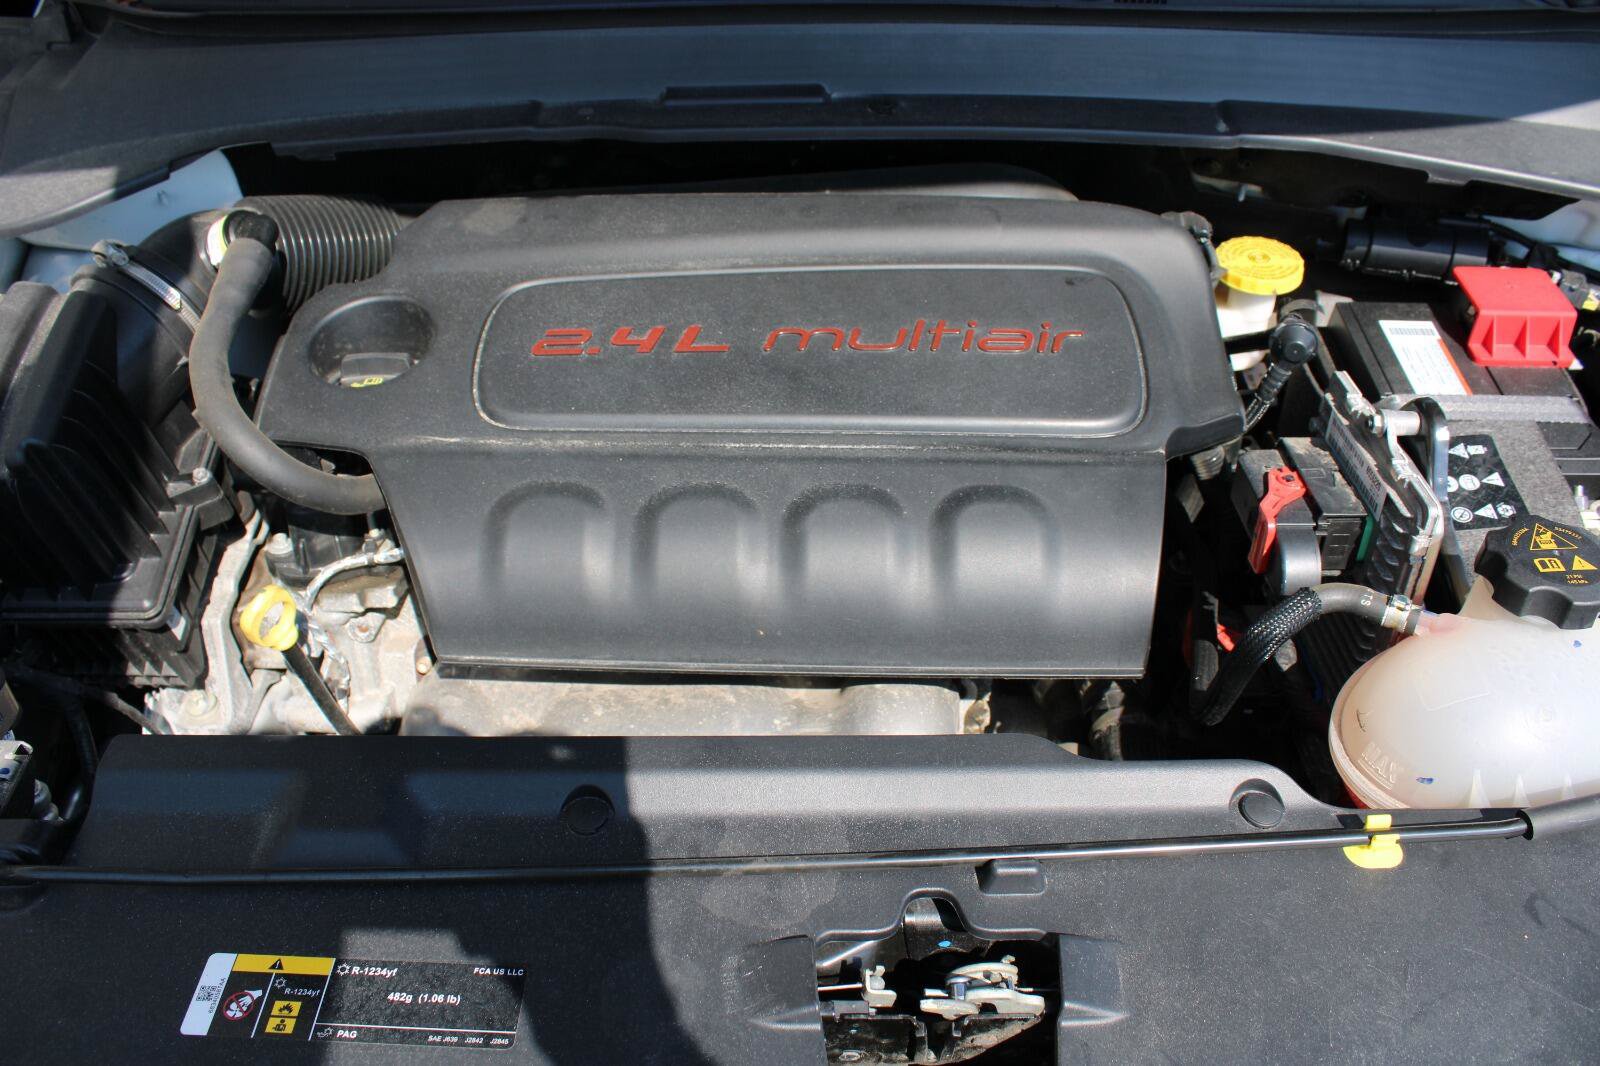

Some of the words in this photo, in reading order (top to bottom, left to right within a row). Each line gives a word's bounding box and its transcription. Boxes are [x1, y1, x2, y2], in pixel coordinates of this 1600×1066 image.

[763, 319, 1084, 353] multiair
[351, 966, 398, 978] R-1234yf
[473, 967, 491, 975] FCA
[284, 987, 320, 997] R-1234yf
[387, 991, 413, 1004] 482g
[418, 993, 444, 1004] (1.06
[446, 994, 461, 1006] lb)
[336, 1029, 358, 1039] PAG
